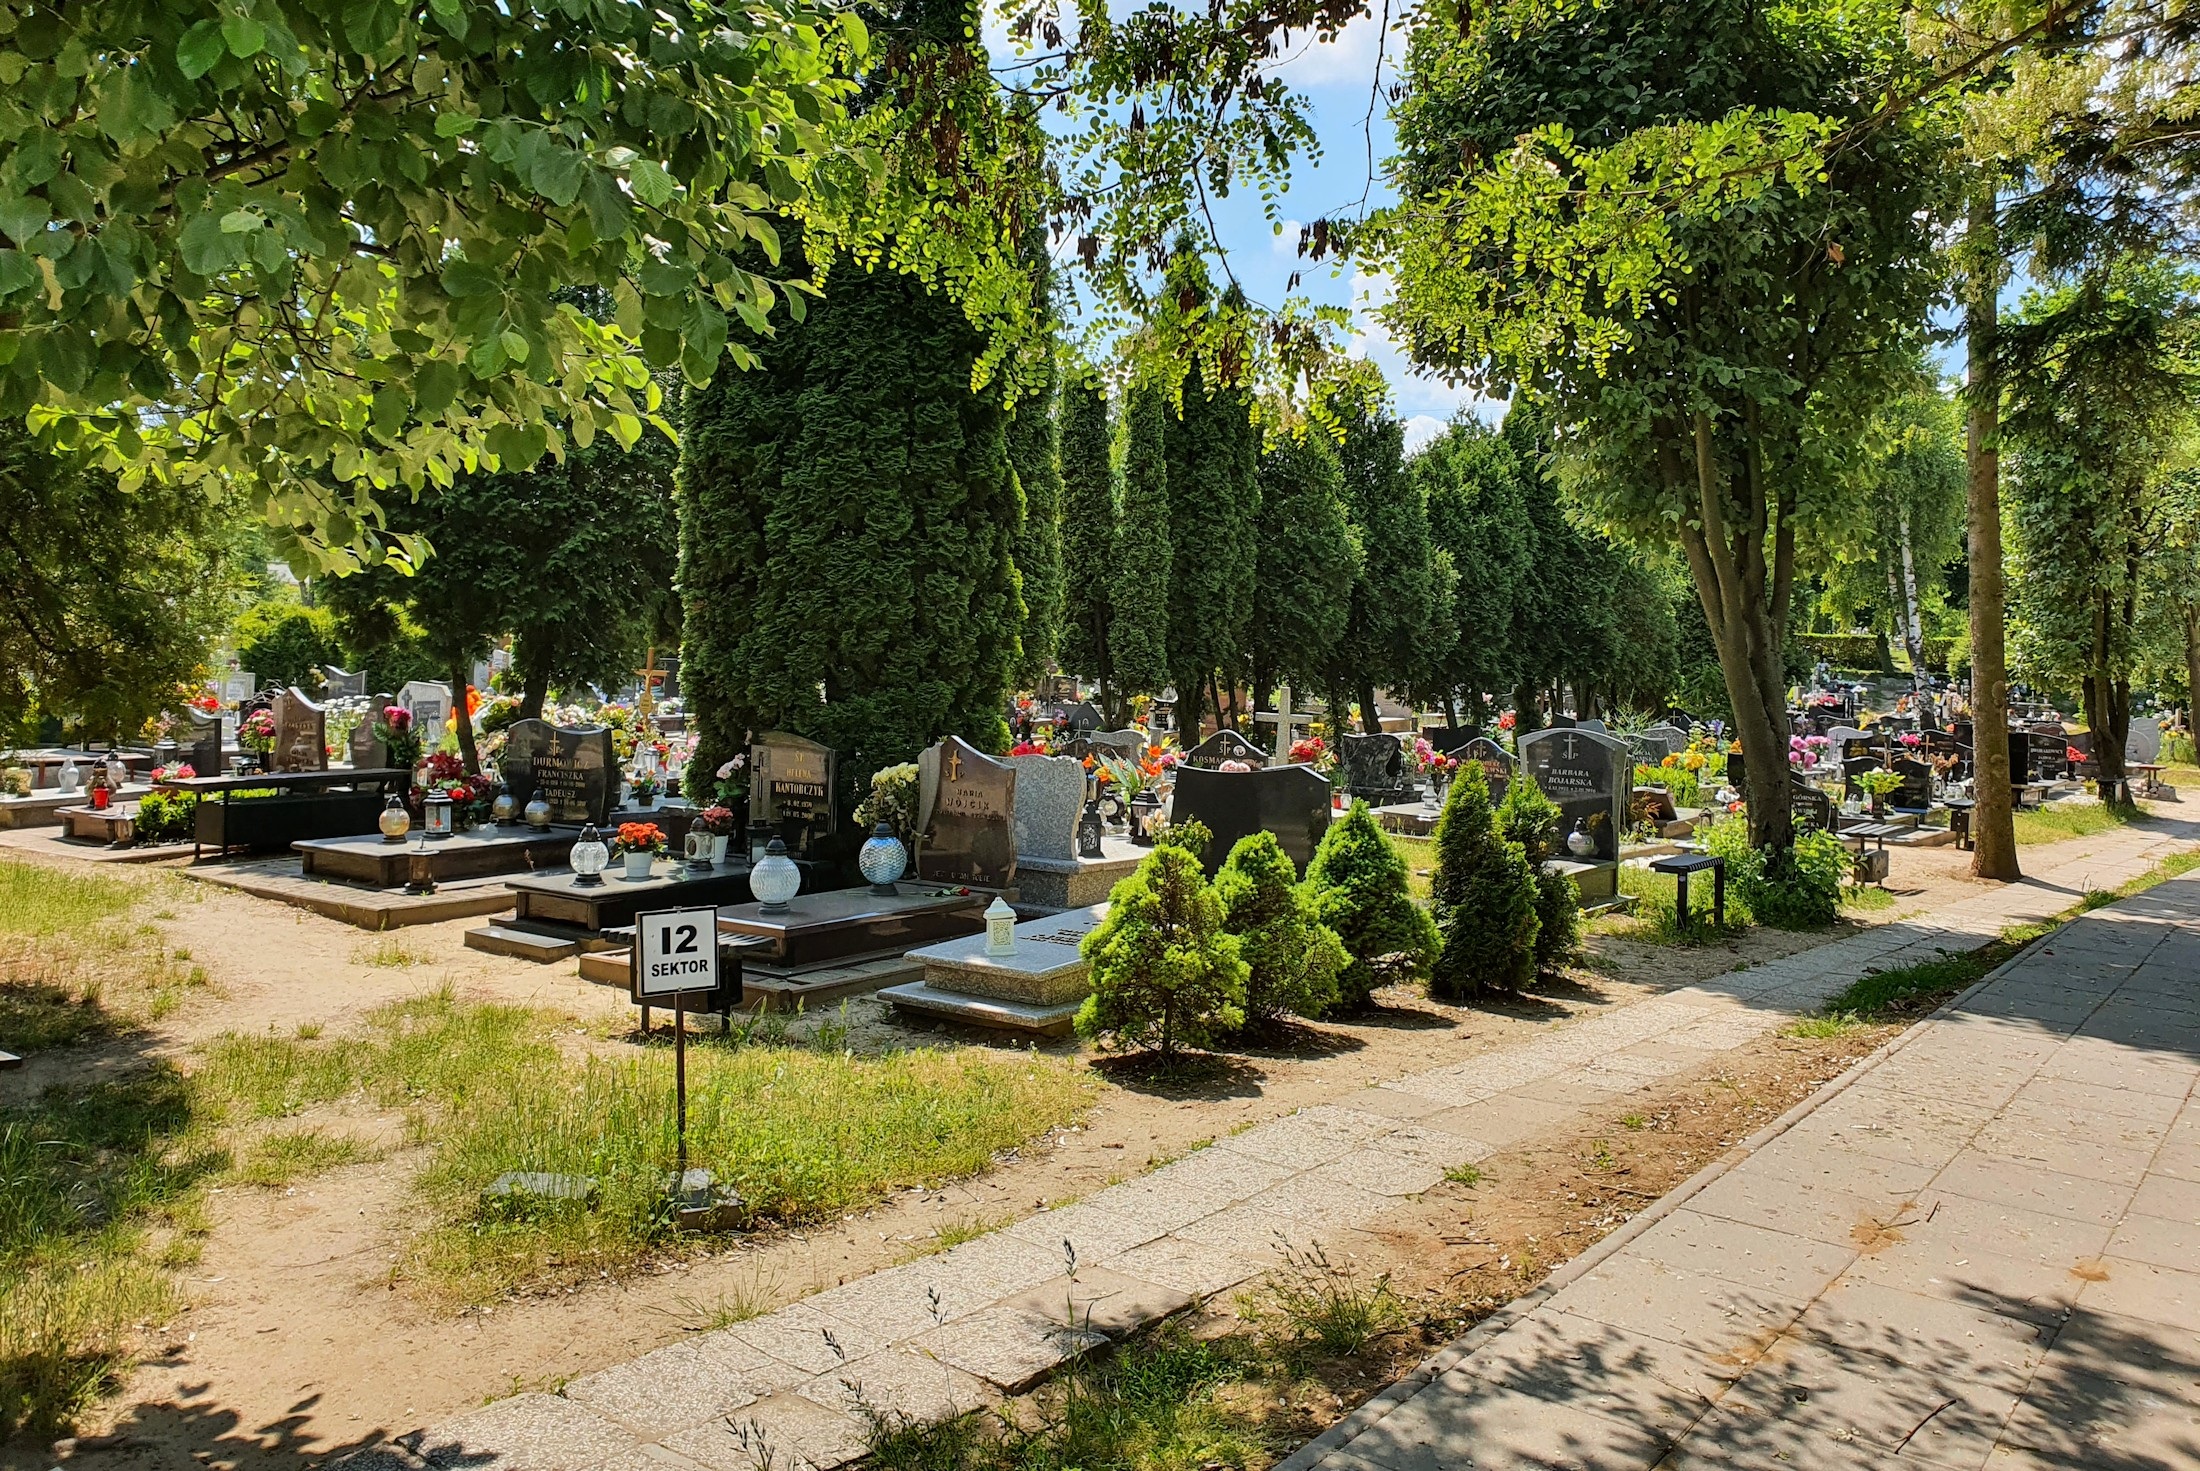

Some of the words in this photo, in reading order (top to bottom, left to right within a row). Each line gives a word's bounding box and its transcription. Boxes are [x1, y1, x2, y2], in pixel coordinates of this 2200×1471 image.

[537, 769, 583, 780] FRANCISZKA
[1551, 768, 1589, 778] BARBARA
[1548, 776, 1592, 787] BOJARSKA
[545, 788, 577, 799] TADEUSZ
[775, 781, 824, 797] KANTORCZYK
[662, 925, 698, 955] 12
[651, 959, 709, 977] SEKTOR
